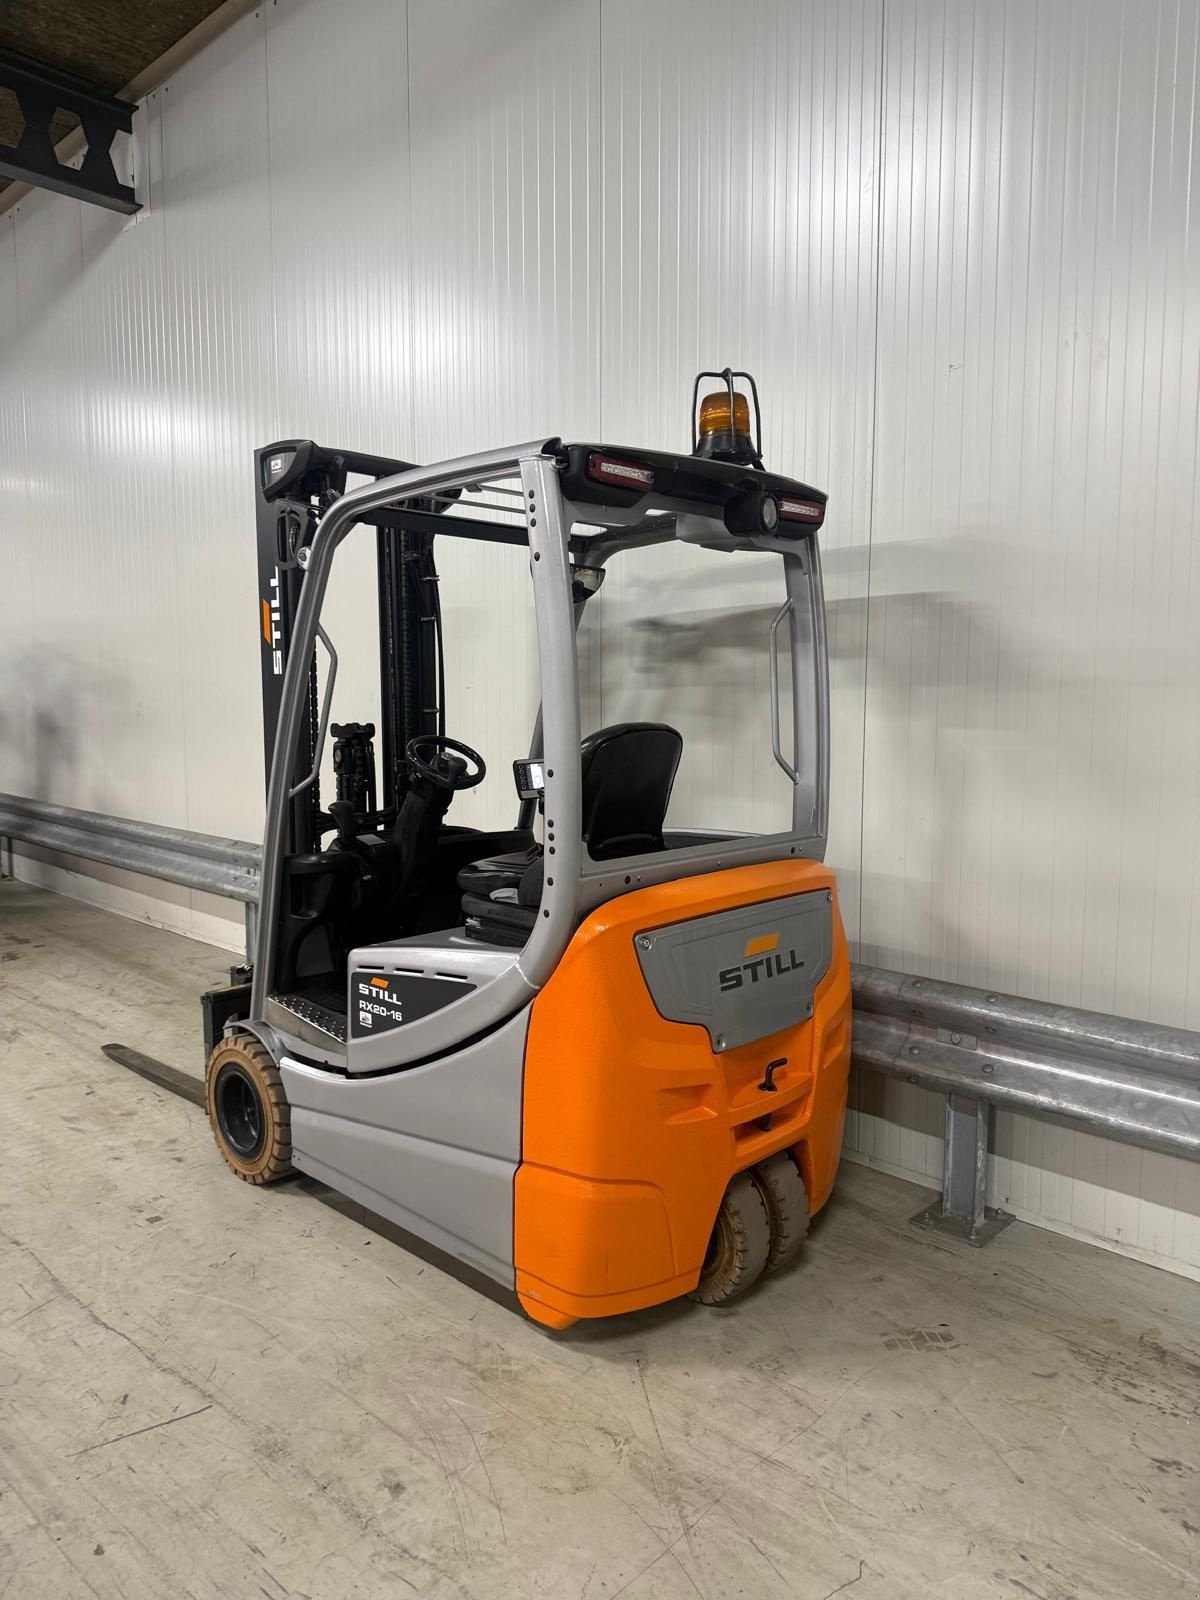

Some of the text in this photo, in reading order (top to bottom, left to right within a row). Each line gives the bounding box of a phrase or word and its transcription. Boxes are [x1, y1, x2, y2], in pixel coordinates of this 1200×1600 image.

[270, 565, 283, 675] STILL
[718, 949, 805, 992] STILL
[358, 983, 402, 1006] STILL
[359, 999, 403, 1022] RX20-16
